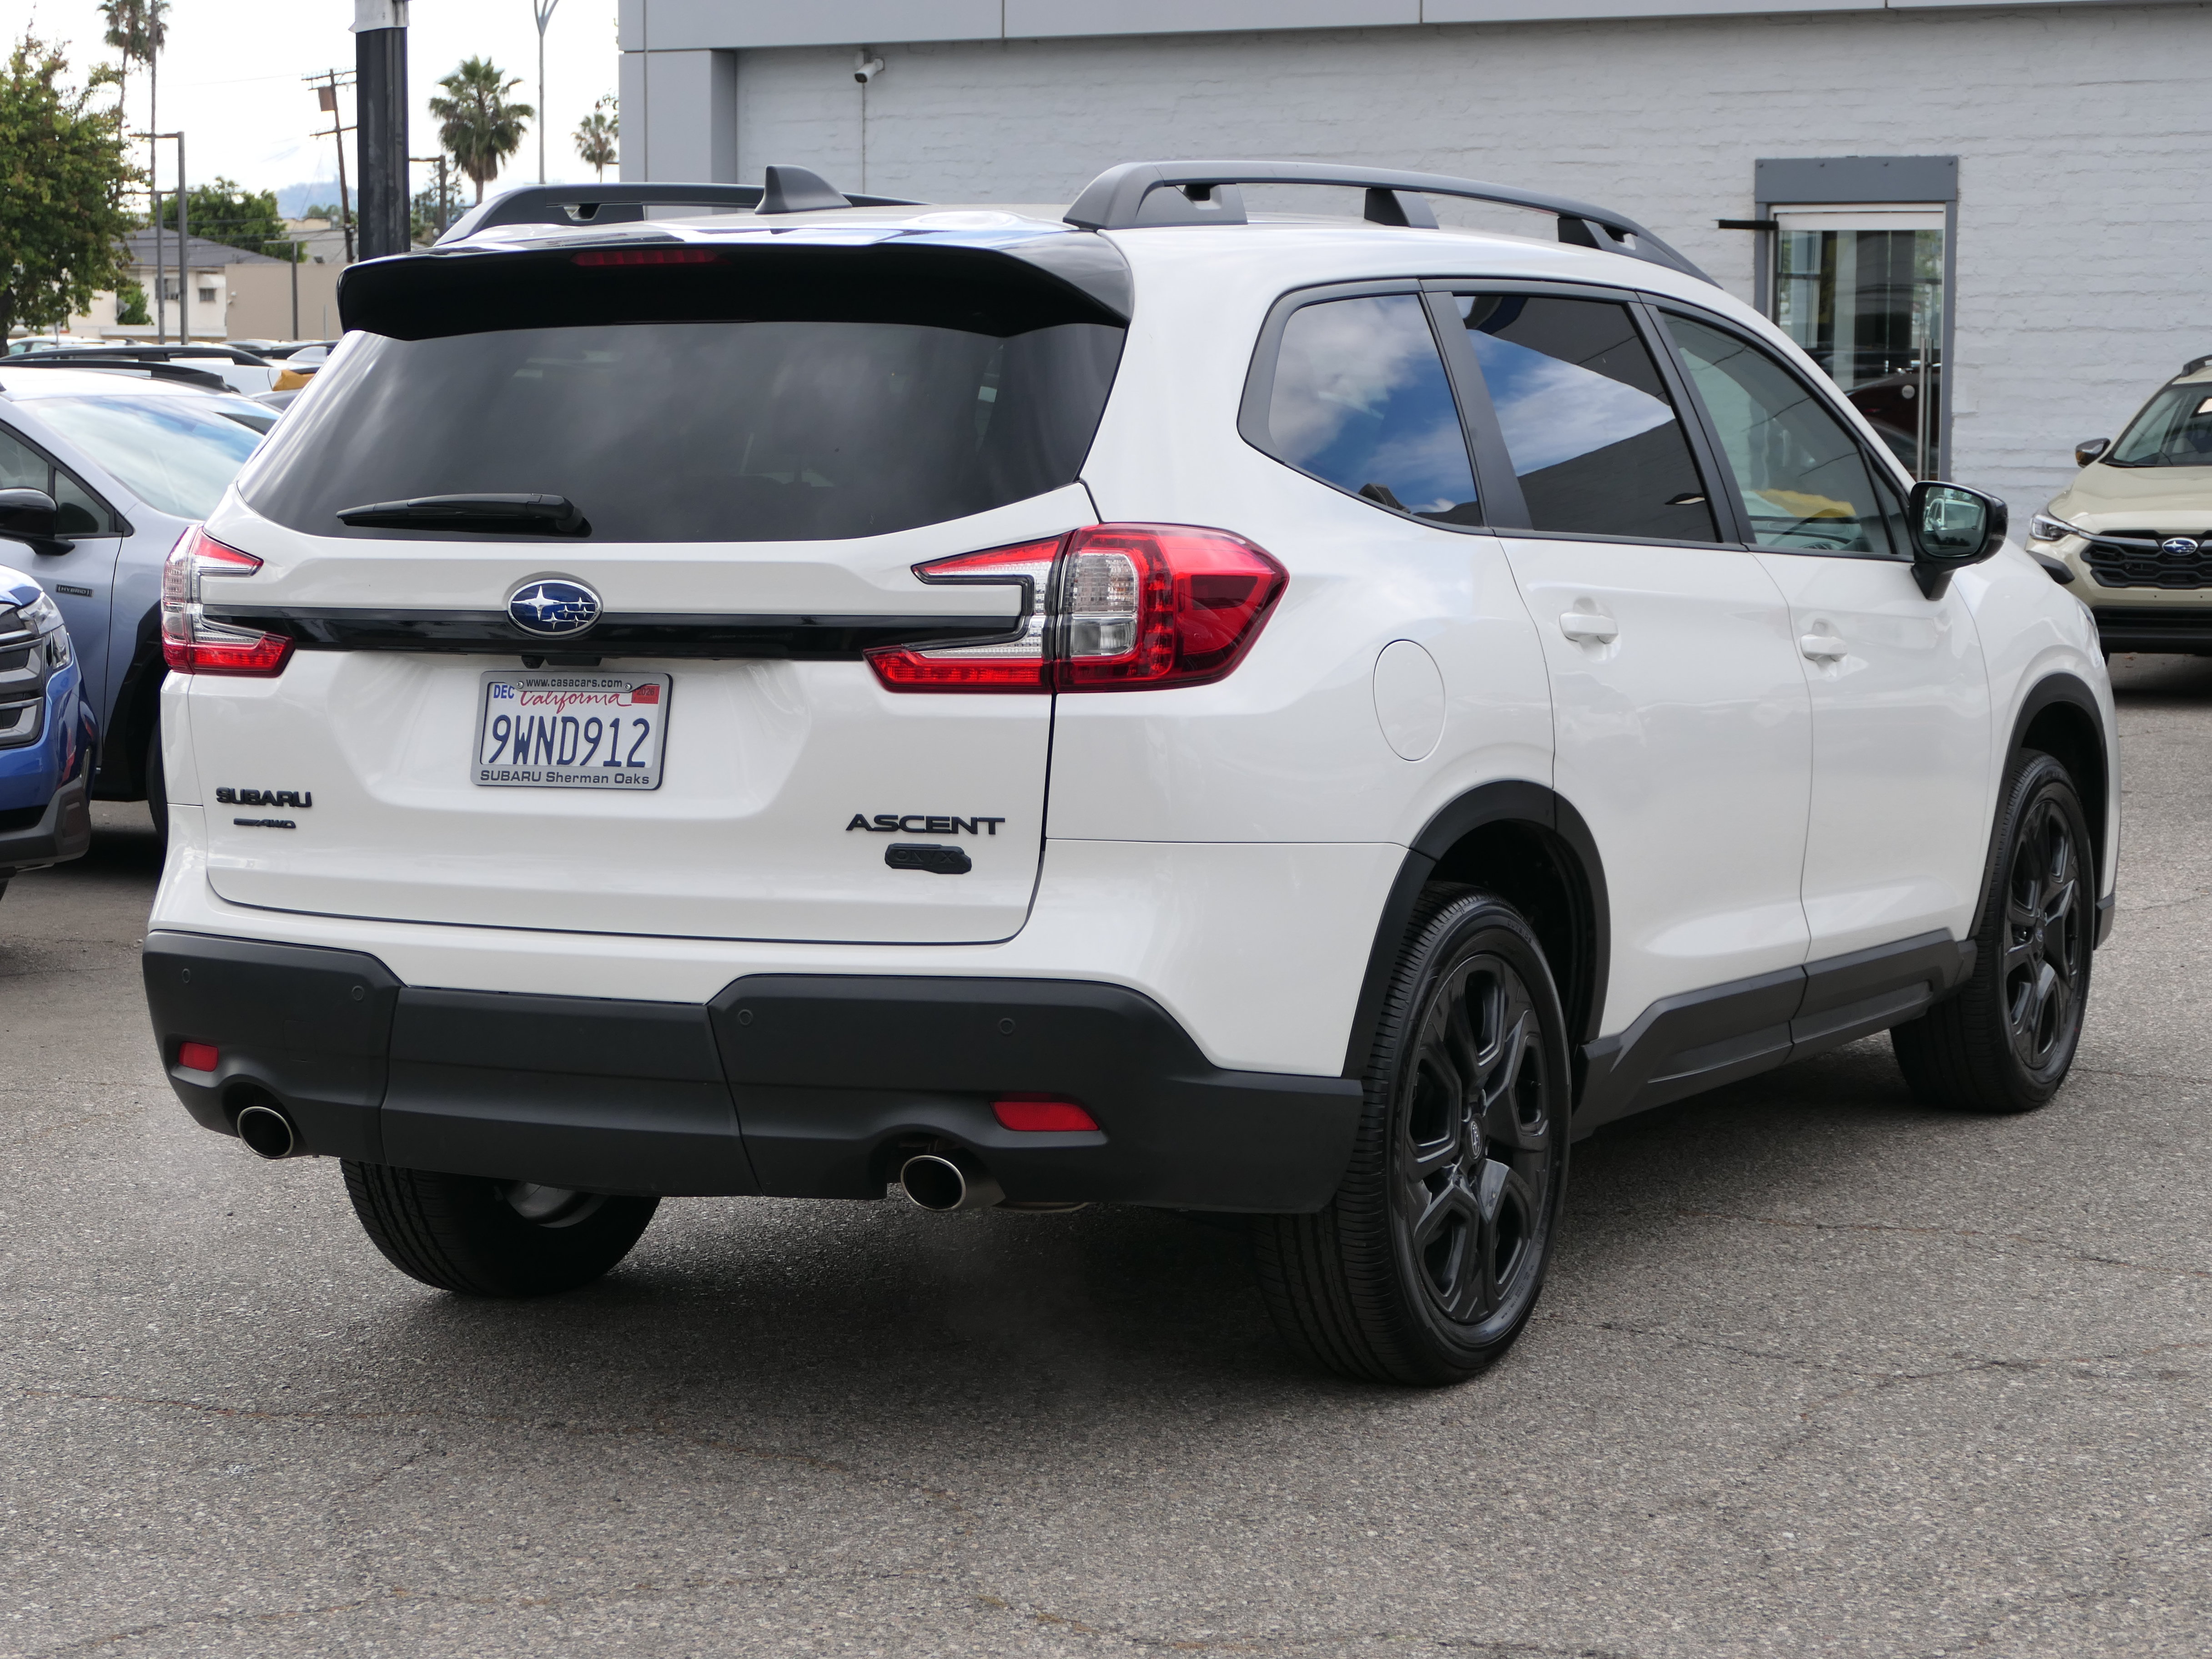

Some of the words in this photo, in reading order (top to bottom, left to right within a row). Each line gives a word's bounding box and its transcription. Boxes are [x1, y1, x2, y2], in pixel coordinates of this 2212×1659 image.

[526, 679, 623, 688] www.casacars.com
[637, 687, 654, 695] 2026
[493, 684, 515, 699] DEC
[520, 691, 632, 714] California
[488, 714, 650, 767] 9WND912
[480, 769, 541, 782] SUBARU
[546, 771, 609, 784] Sherman
[614, 773, 650, 784] Oaks
[216, 786, 312, 808] SUBARU
[255, 819, 297, 829] AWD
[845, 814, 1005, 835] ASCENT
[894, 849, 955, 865] ONYX
